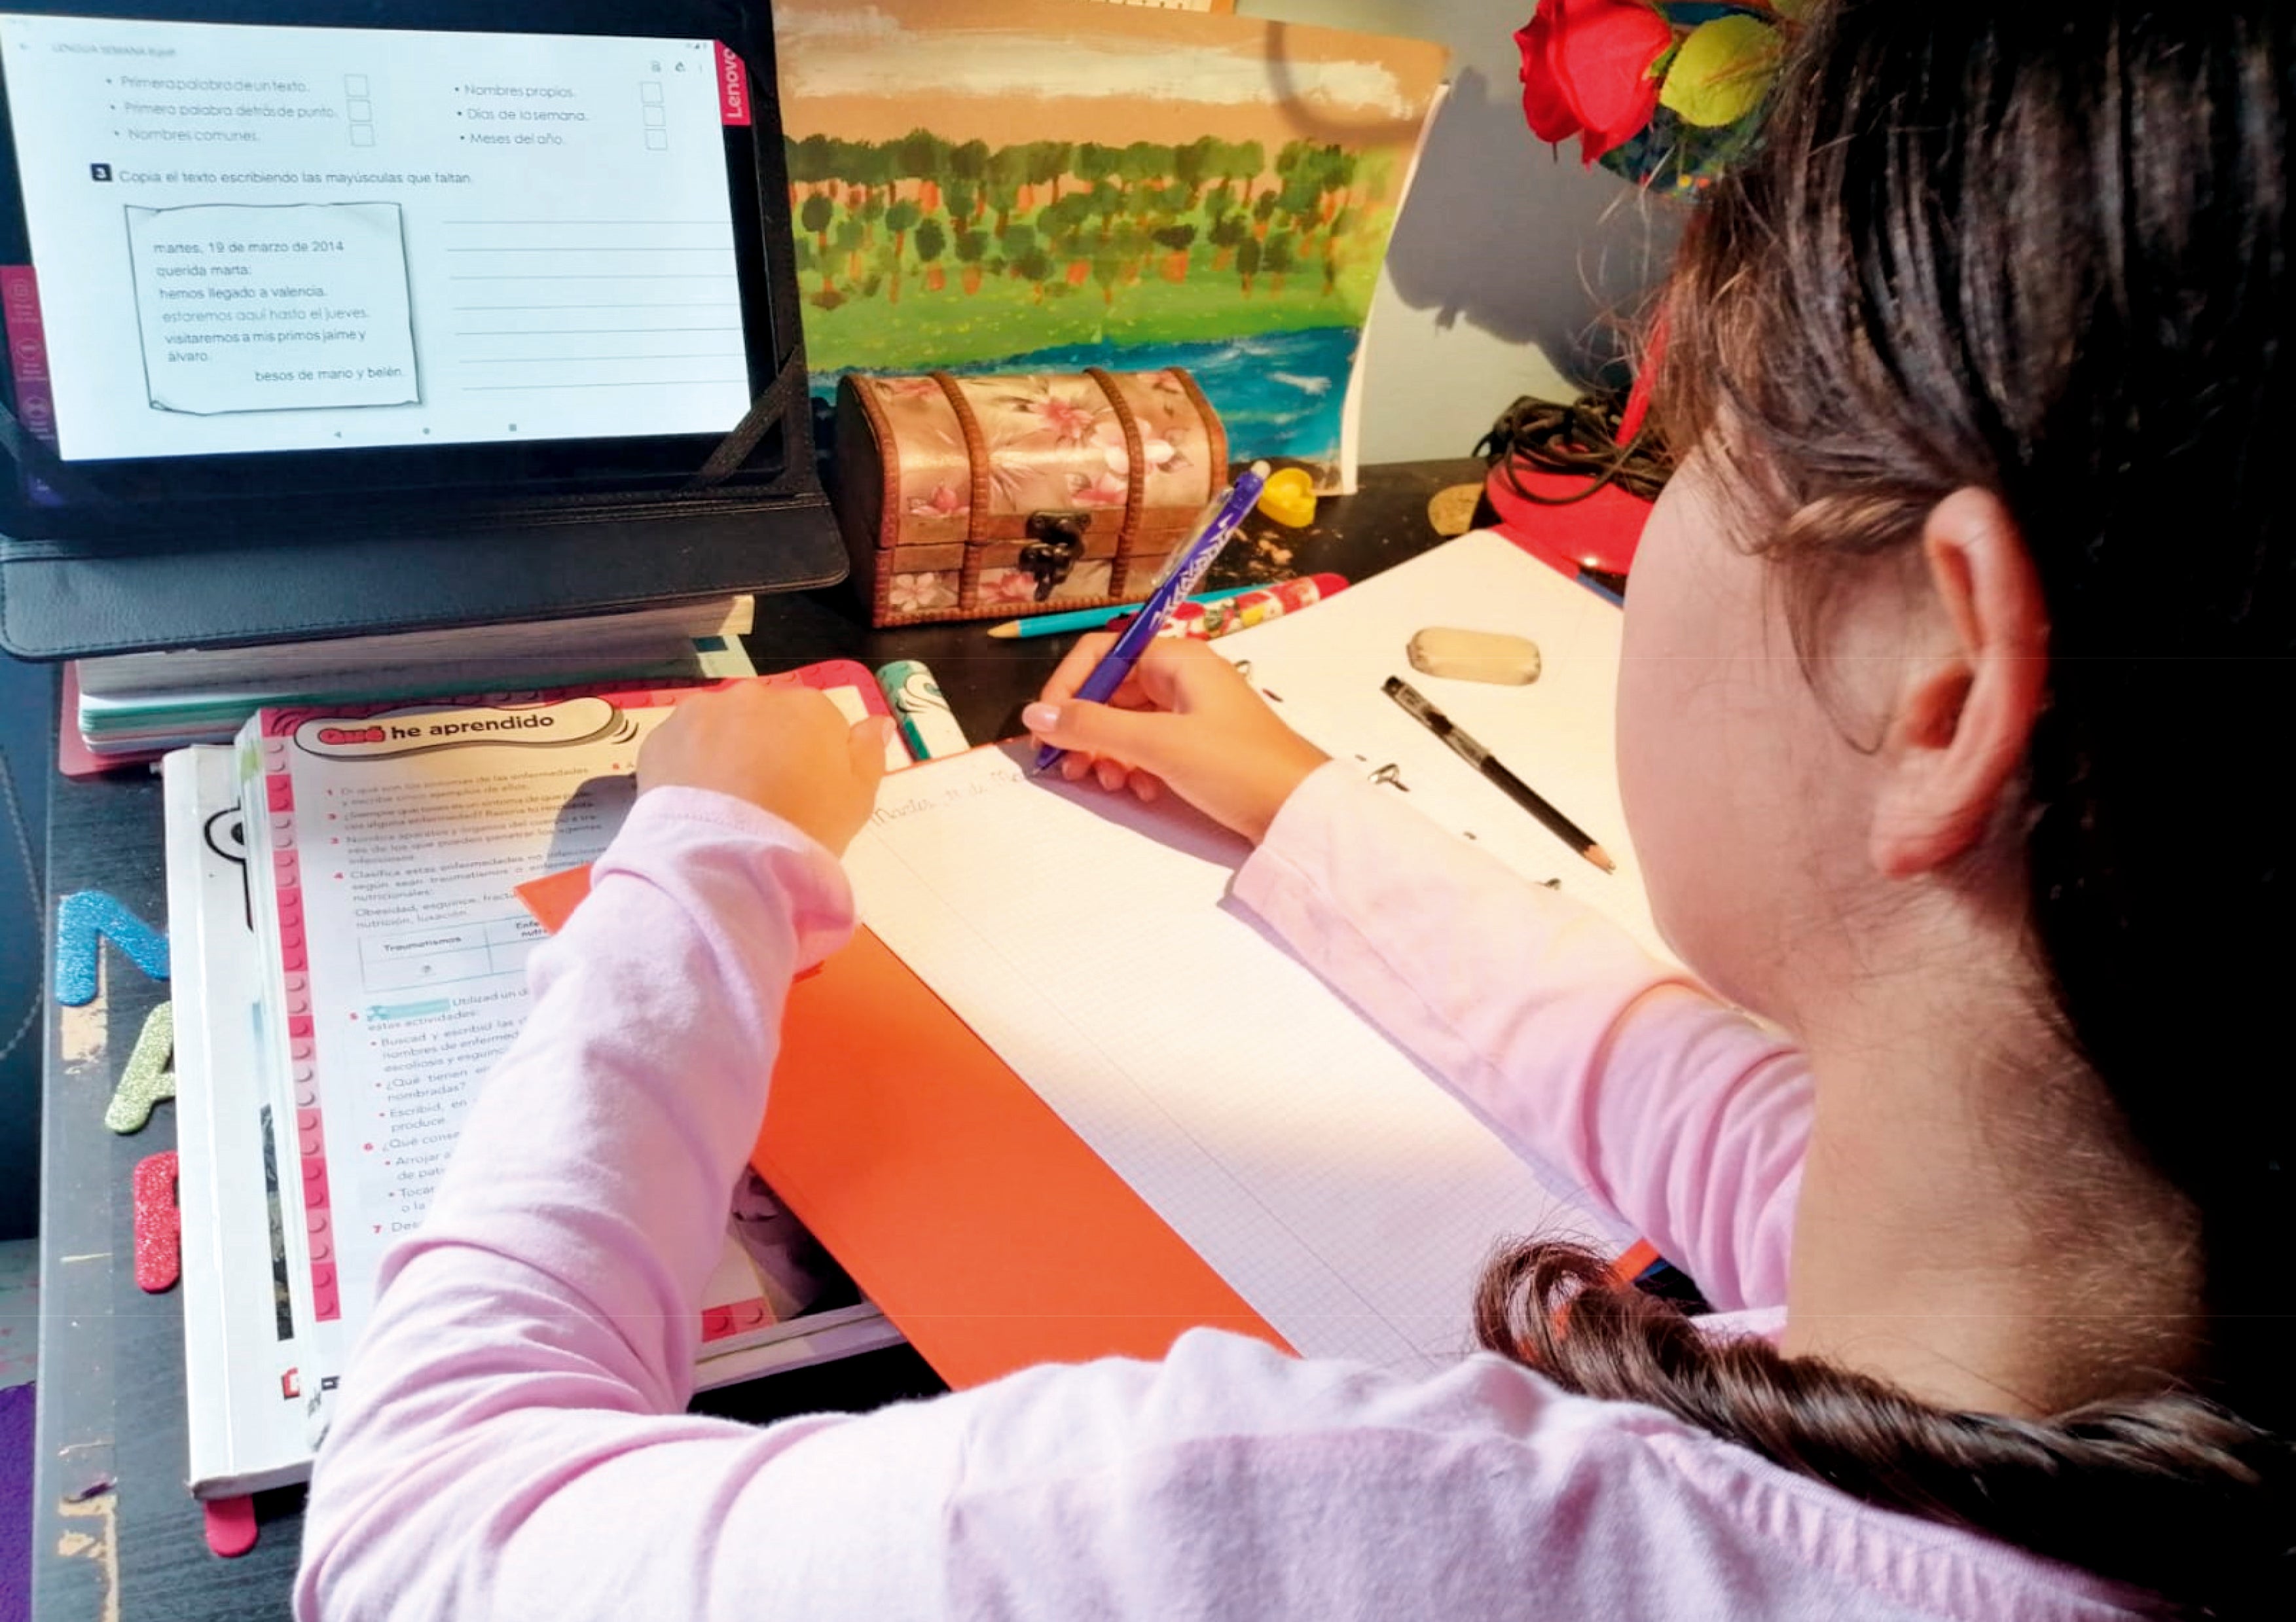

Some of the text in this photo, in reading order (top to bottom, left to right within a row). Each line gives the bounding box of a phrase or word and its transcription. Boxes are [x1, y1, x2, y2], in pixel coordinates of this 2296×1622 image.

[723, 47, 743, 118] Lenovo
[464, 83, 523, 96] Nombres
[498, 108, 516, 120] de
[519, 109, 532, 120] la
[128, 129, 193, 141] Nombres
[470, 132, 511, 144] Meses
[514, 132, 534, 144] del
[119, 170, 162, 184] Copia
[166, 169, 179, 183] el
[183, 171, 217, 183] texto
[221, 168, 299, 183] escribiendo
[302, 169, 322, 183] las
[325, 168, 404, 187] mayúsculas
[407, 173, 432, 187] que
[208, 241, 225, 253] 19
[228, 242, 245, 253] de
[248, 242, 288, 253] marzo
[292, 241, 308, 252] de
[311, 240, 344, 252] 2014
[156, 265, 207, 278] querida
[159, 287, 205, 299] hemos
[208, 285, 255, 301] llegado
[259, 289, 268, 298] a
[162, 310, 232, 323] estaremos
[269, 308, 306, 319] hasta
[310, 307, 323, 319] el
[164, 329, 367, 344] visitaremos a mis primos jaime y
[255, 369, 295, 382] besos
[298, 370, 314, 381] de
[355, 369, 365, 381] y
[391, 726, 421, 739] he
[429, 715, 554, 736] aprendido
[384, 937, 462, 951] Traumatismos
[373, 1225, 381, 1234] 7
